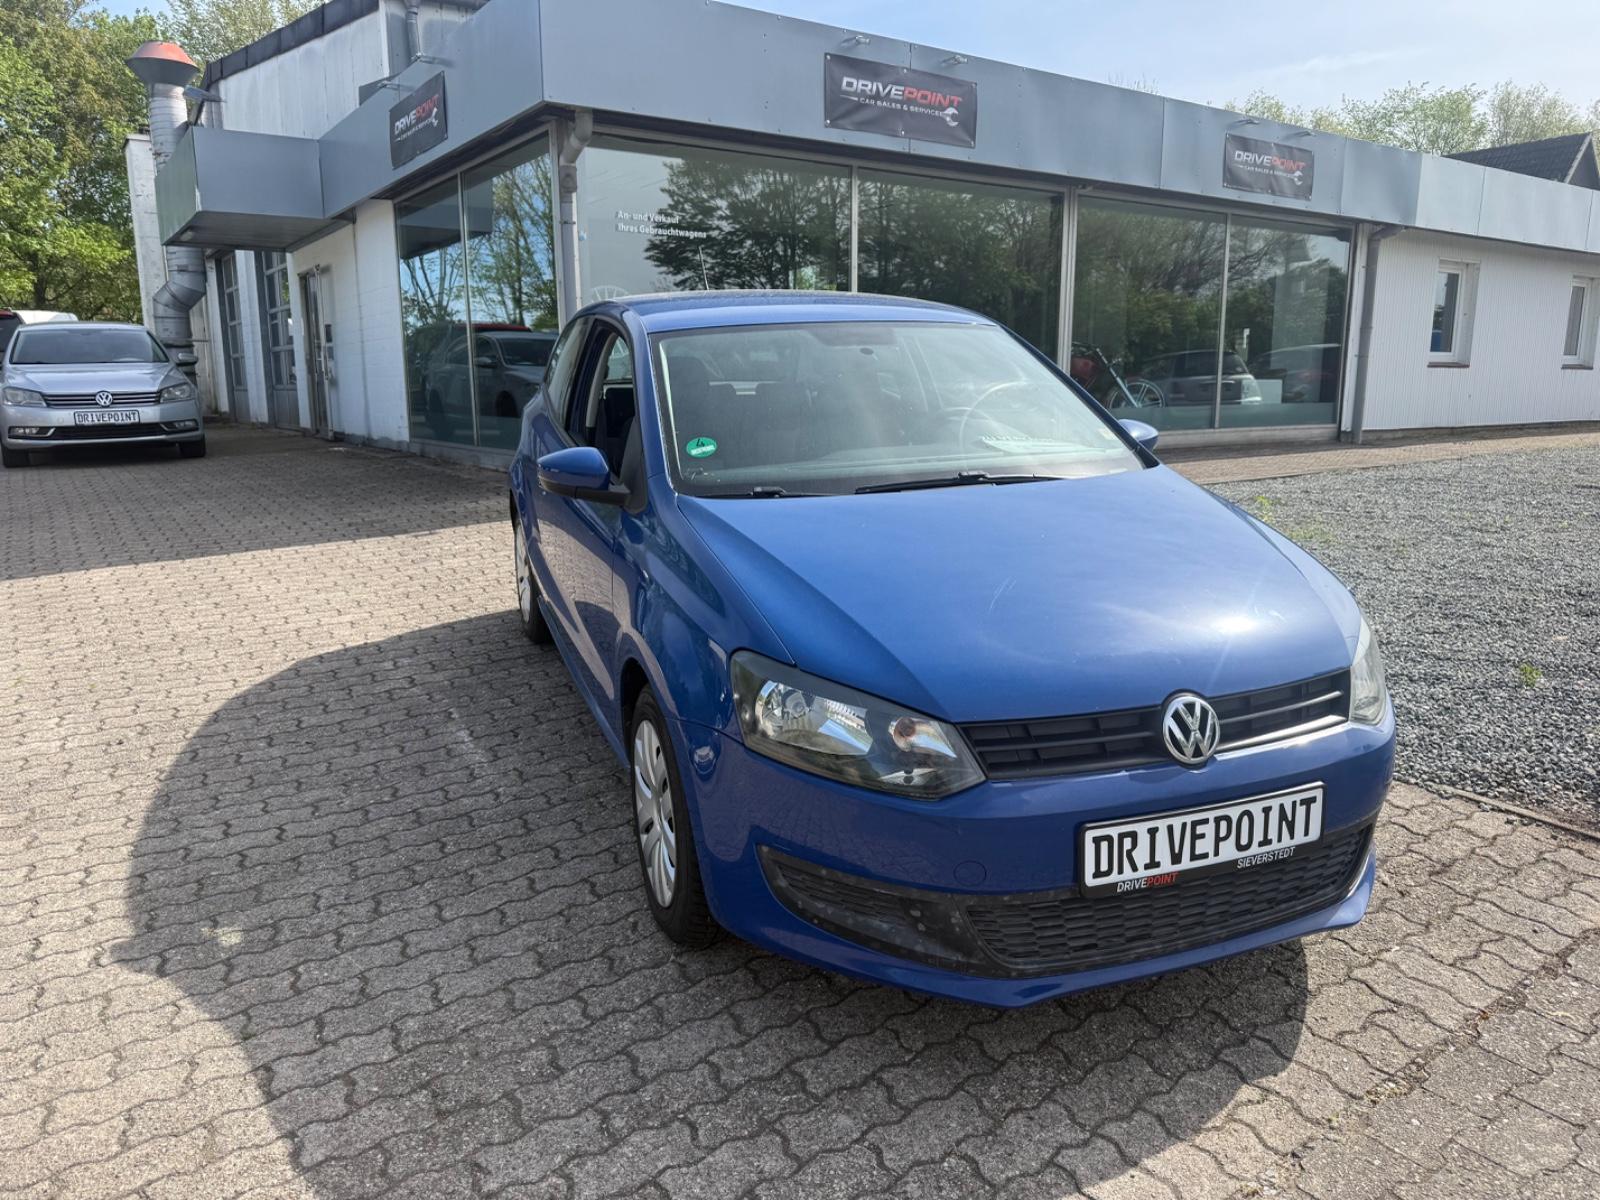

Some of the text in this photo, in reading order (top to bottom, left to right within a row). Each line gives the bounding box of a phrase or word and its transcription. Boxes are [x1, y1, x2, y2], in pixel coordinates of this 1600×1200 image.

[841, 76, 962, 107] DRIVEPOINT
[860, 97, 875, 105] CAR
[876, 100, 902, 109] SALES
[1234, 150, 1306, 171] DRIVEPOINT
[617, 223, 638, 233] Ihres
[633, 212, 648, 221] und
[649, 213, 679, 224] Verkauf
[77, 412, 137, 423] DRIVEPOINT
[1092, 795, 1317, 880] DRIVEPOINT
[1237, 846, 1296, 869] SIEVERSTEDT
[1117, 872, 1179, 893] DRIVEPOINT
